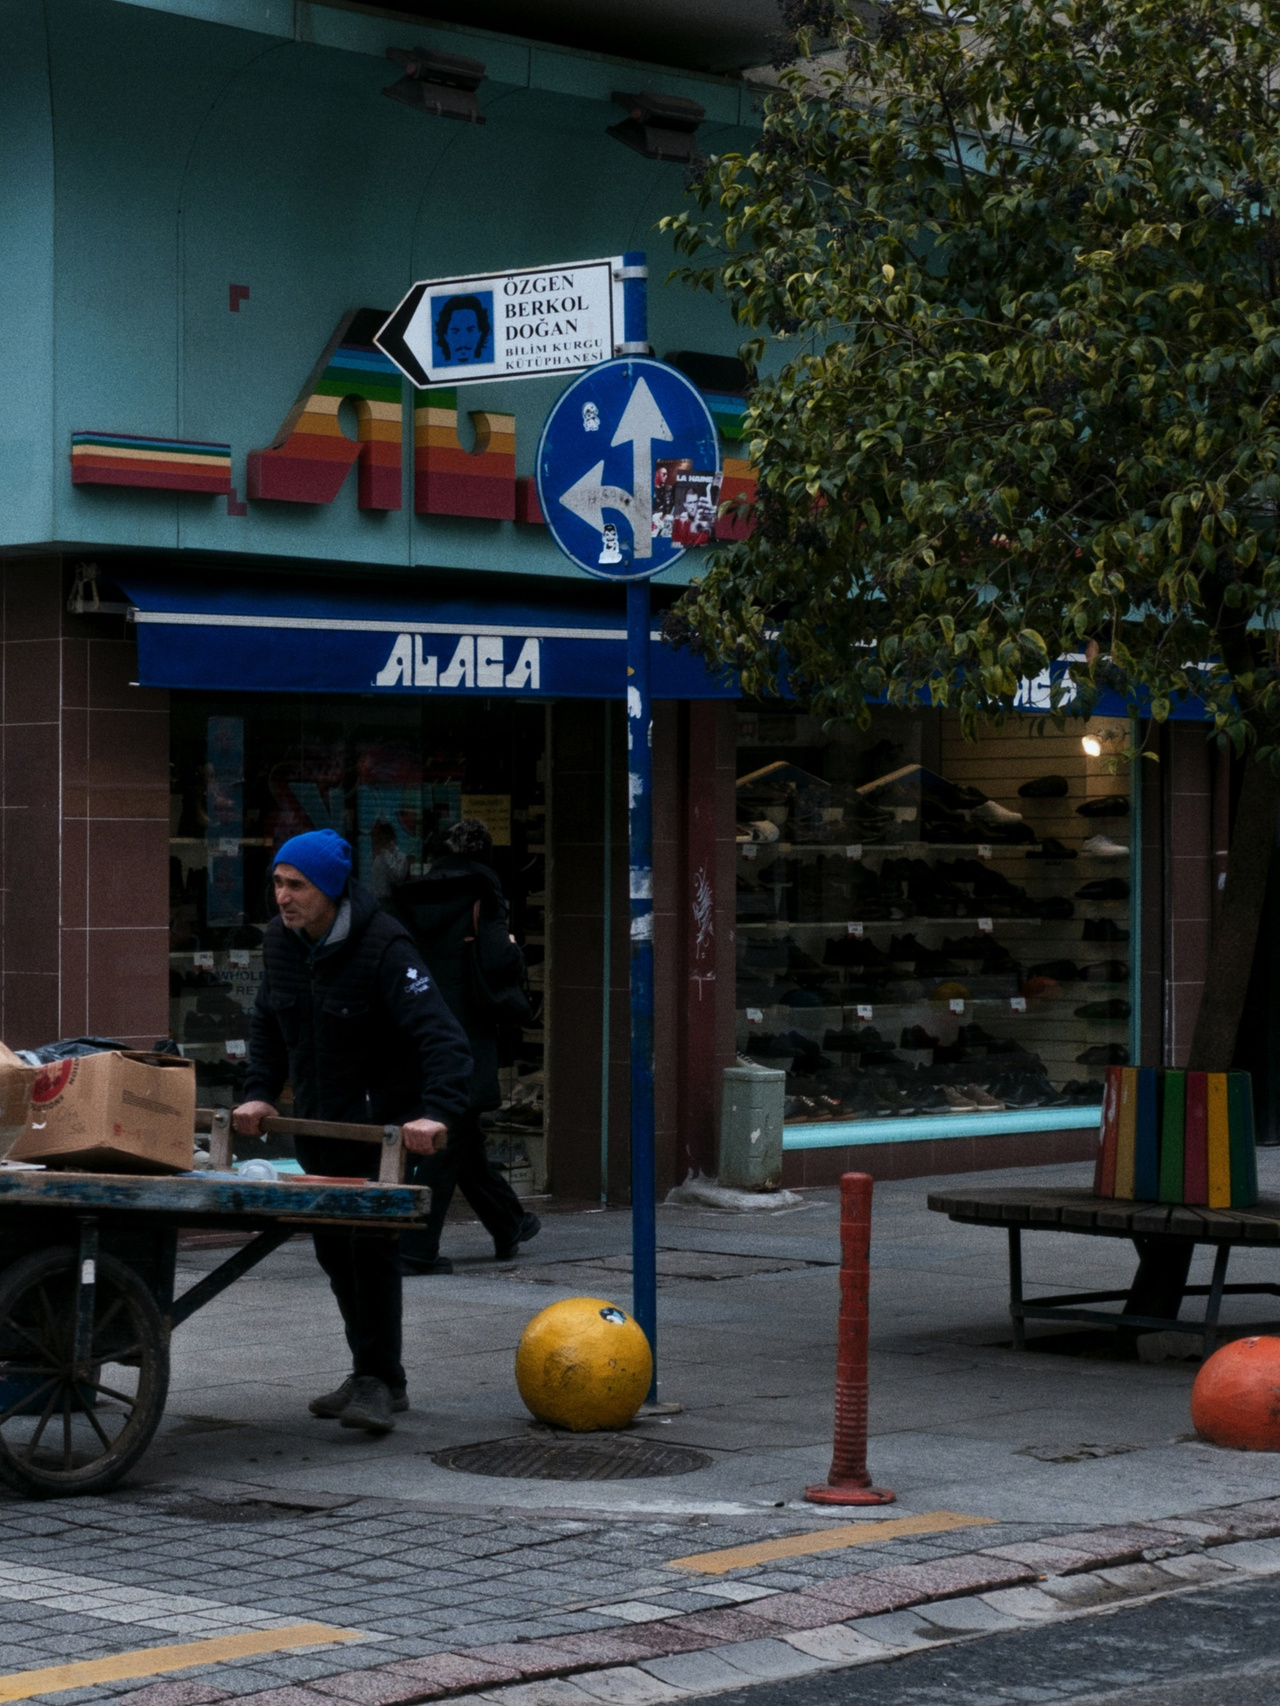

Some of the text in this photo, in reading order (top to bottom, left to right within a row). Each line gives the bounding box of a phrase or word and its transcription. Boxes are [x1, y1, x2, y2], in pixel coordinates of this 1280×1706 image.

[503, 274, 575, 297] ÖZGEN
[505, 296, 589, 319] BERKOL
[505, 318, 578, 341] DOĞAN
[505, 339, 603, 357] BİLİM KURGU
[505, 349, 603, 370] KÜTÜPHANESİ
[676, 474, 687, 482] LA
[376, 633, 541, 689] ALACA
